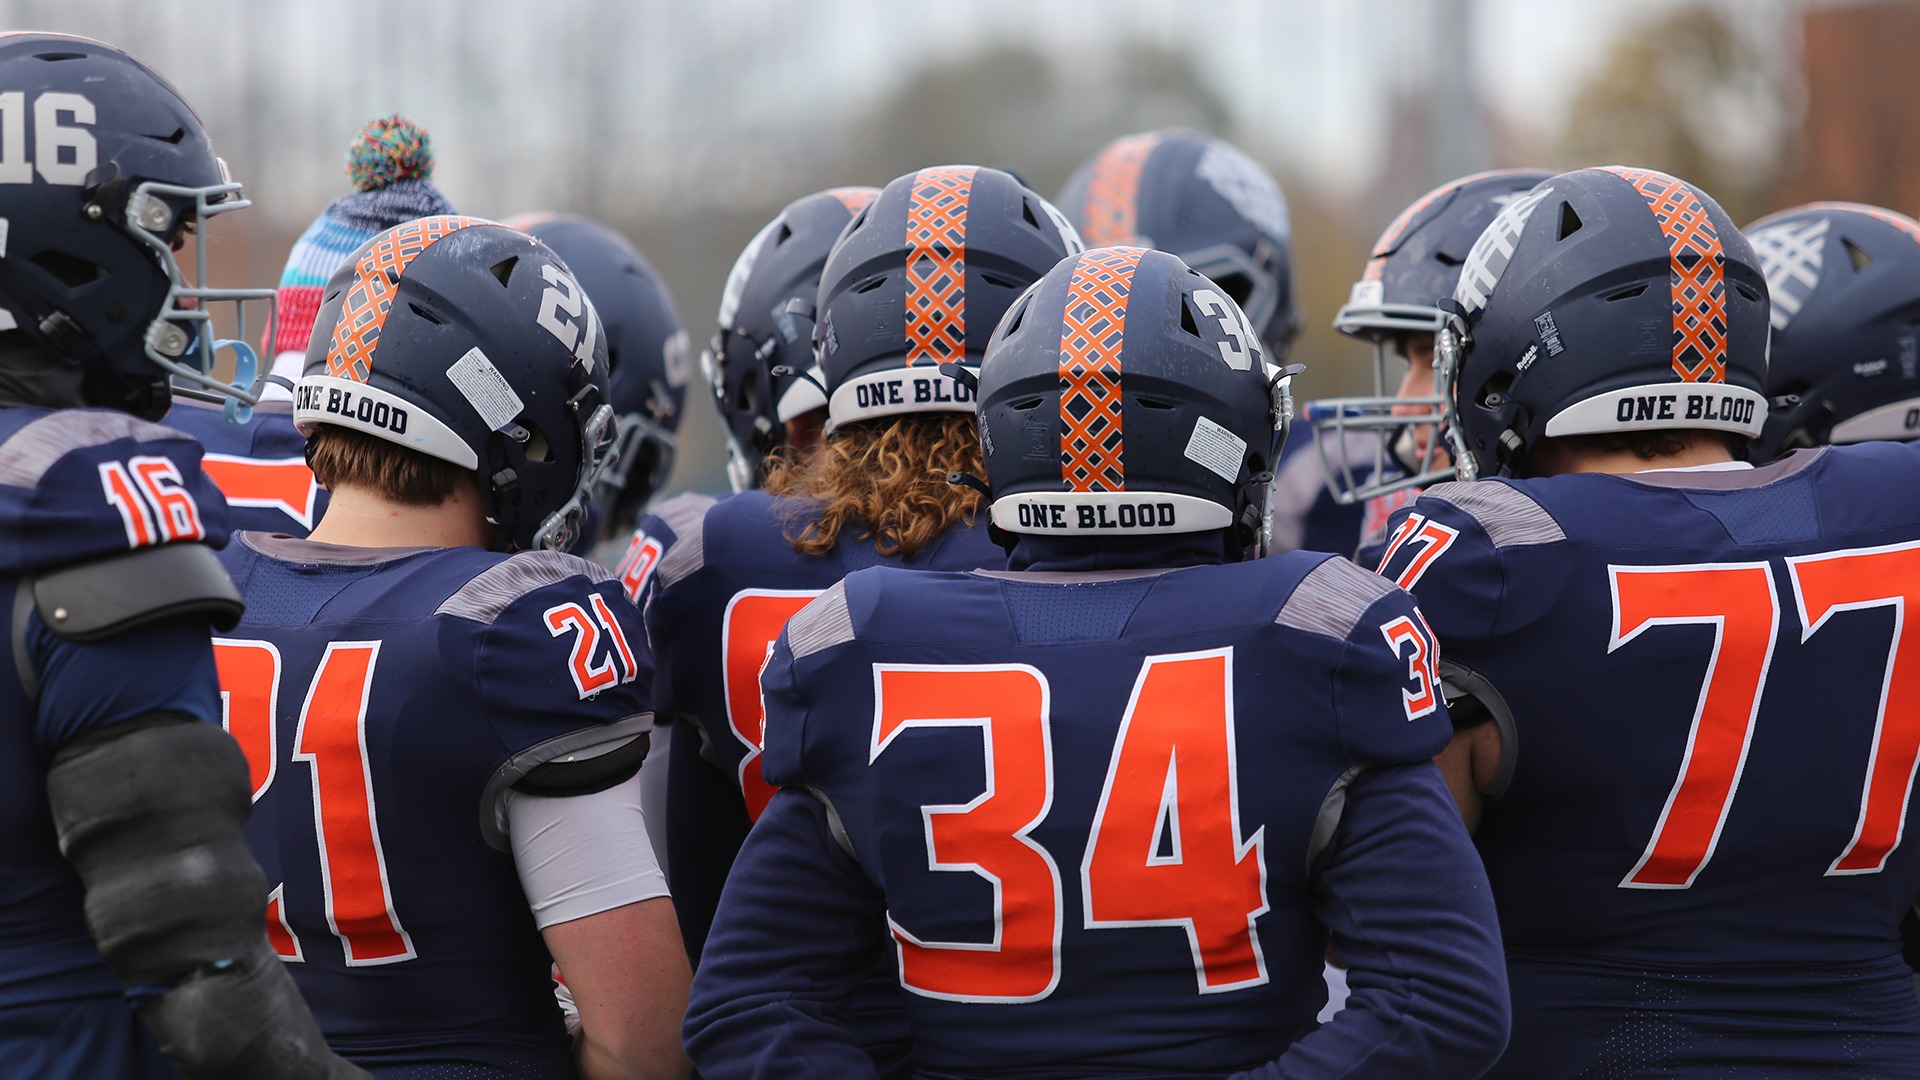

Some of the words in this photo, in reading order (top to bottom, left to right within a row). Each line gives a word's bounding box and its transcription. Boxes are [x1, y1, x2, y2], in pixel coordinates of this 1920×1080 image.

[0, 91, 98, 186] 16
[537, 264, 597, 376] 21
[296, 385, 323, 410] ONE
[326, 388, 408, 435] BLOOD
[488, 366, 510, 392] WARNING
[857, 379, 904, 408] ONE
[913, 378, 977, 403] BLO
[1617, 395, 1676, 423] ONE
[1685, 395, 1755, 425] BLOOD
[1216, 426, 1236, 442] WARNING
[98, 455, 206, 549] 16
[1018, 503, 1067, 528] ONE
[1076, 503, 1176, 528] BLOOD
[1375, 512, 1460, 592] 77
[543, 593, 638, 700] 21
[1607, 541, 1920, 890] 77
[870, 646, 1270, 1004] 34
